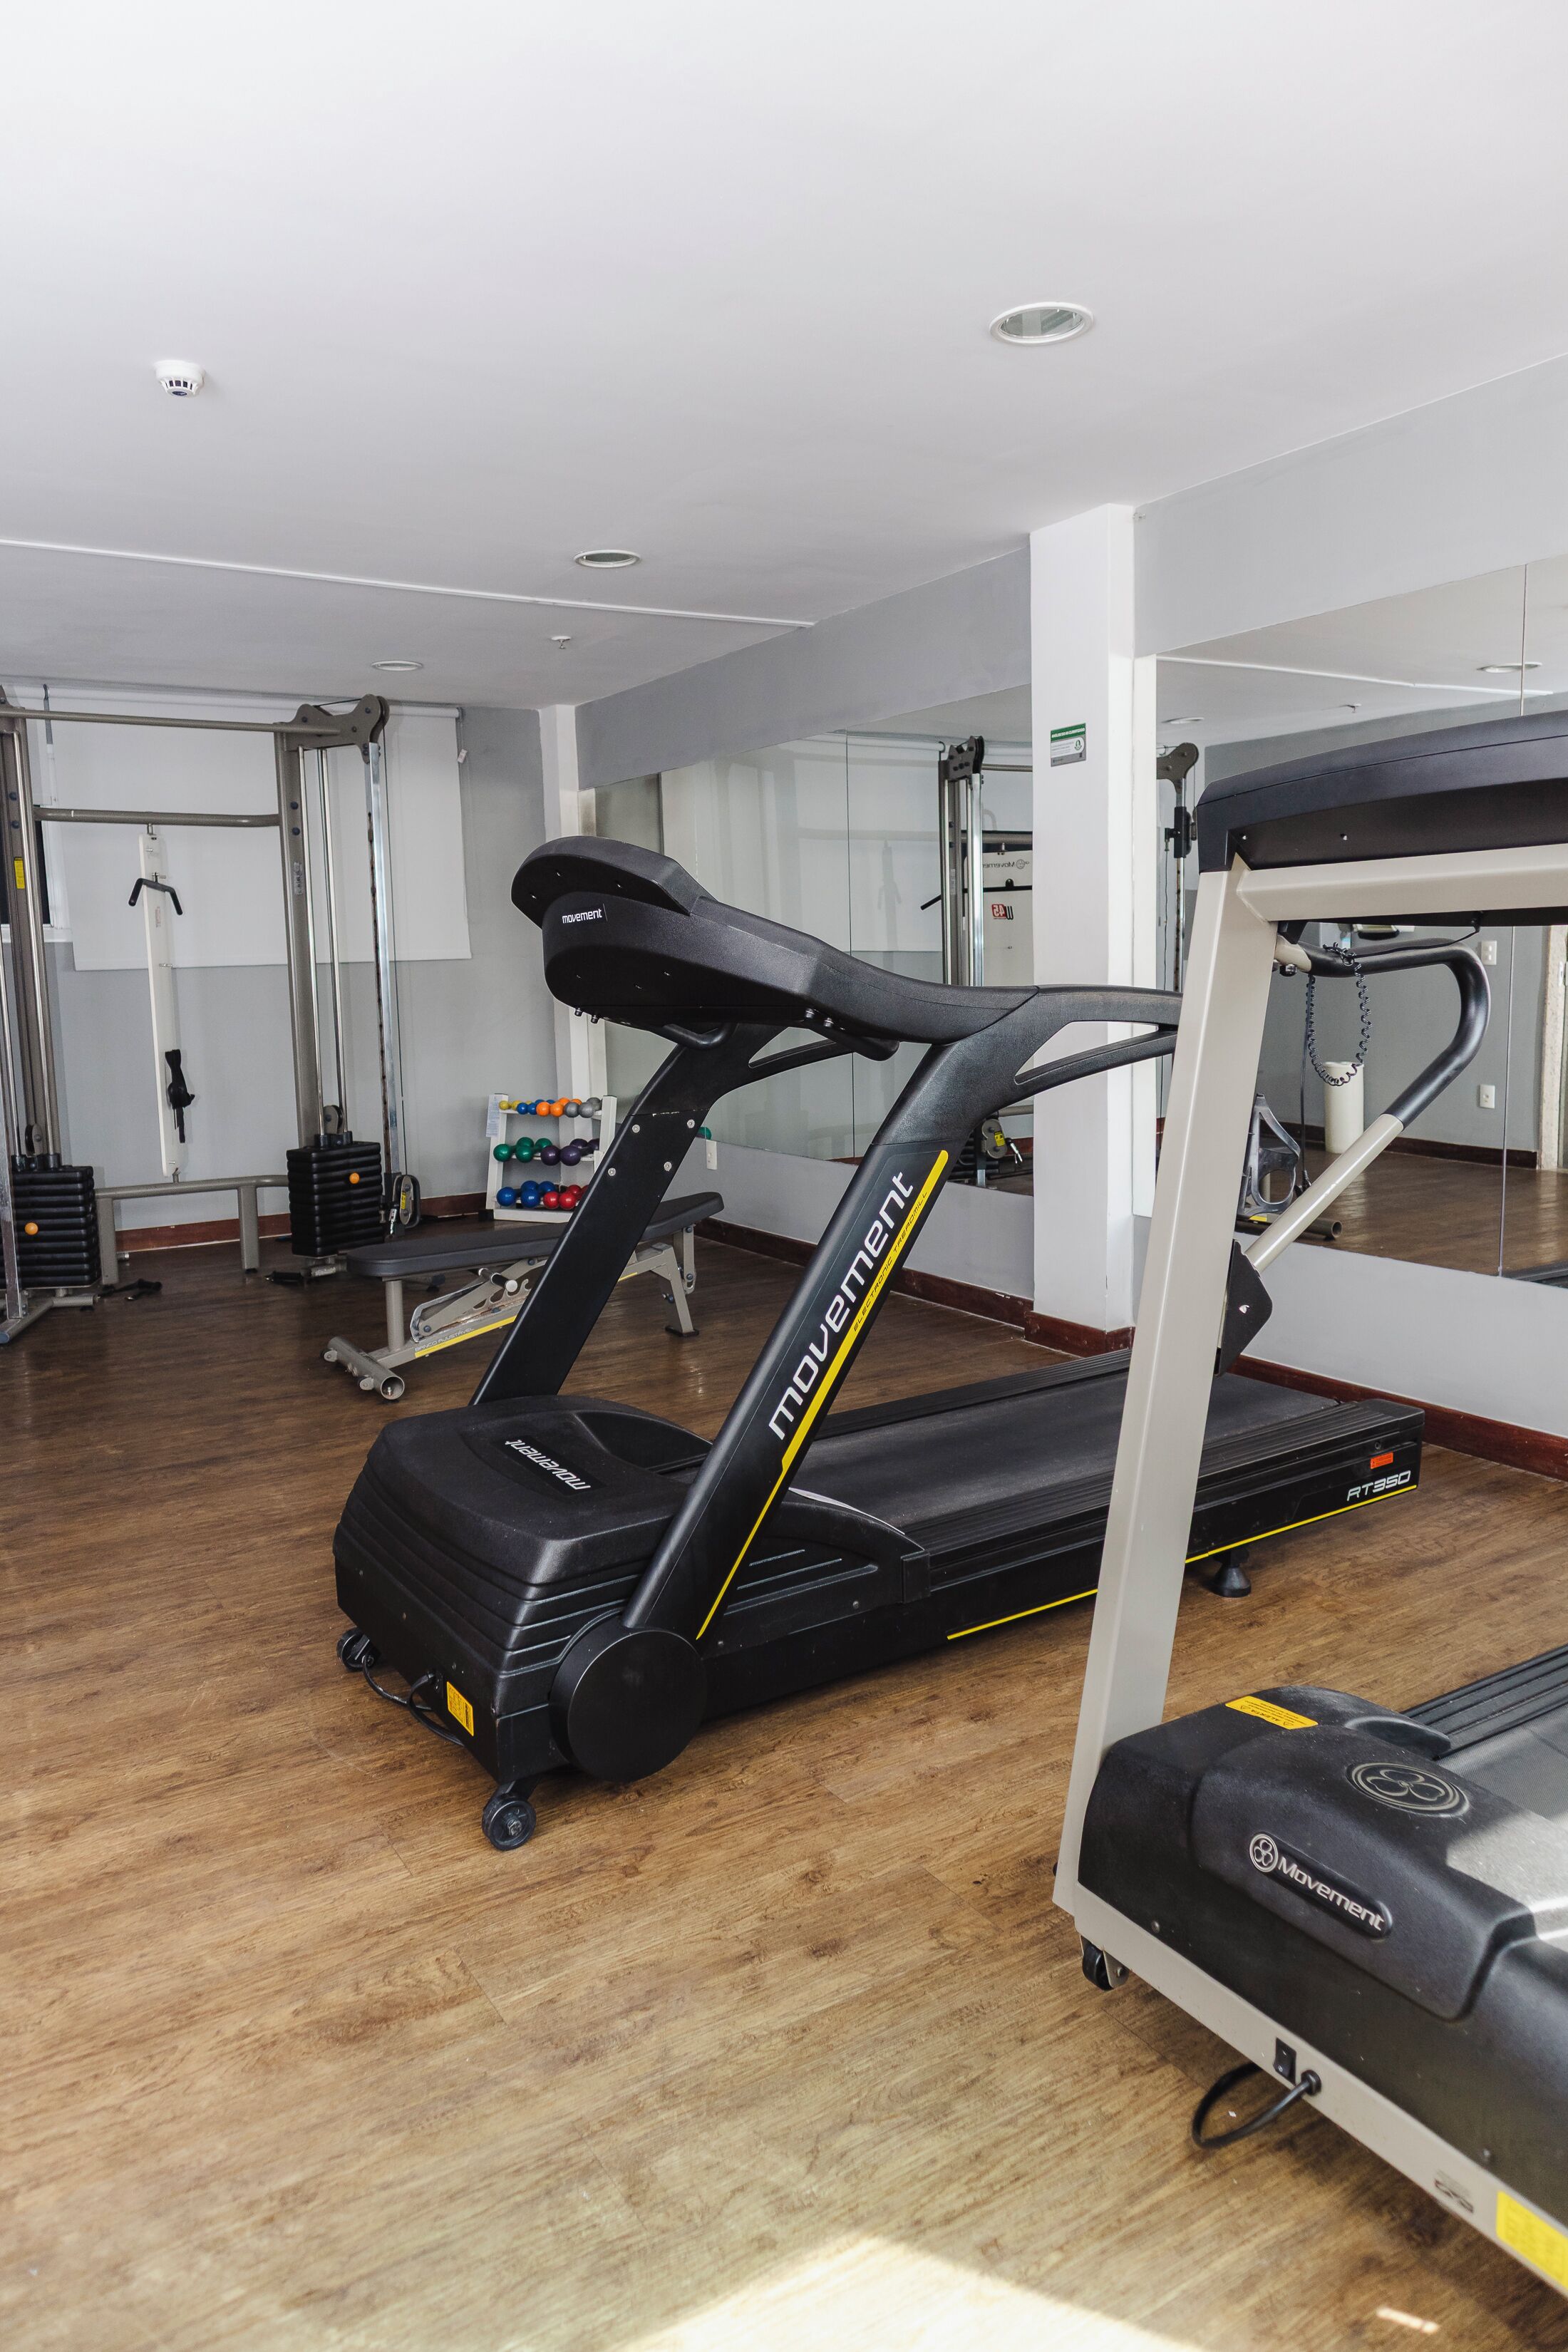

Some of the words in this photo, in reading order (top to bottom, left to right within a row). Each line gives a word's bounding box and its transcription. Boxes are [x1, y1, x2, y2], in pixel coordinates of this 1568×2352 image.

[562, 908, 602, 924] movement
[853, 1256, 893, 1332] ELECTRONIC
[893, 1191, 928, 1254] TREADMILL
[768, 1171, 914, 1441] movement
[414, 1340, 438, 1352] BANCO
[505, 1439, 592, 1490] movement
[1346, 1470, 1411, 1502] RT350
[1277, 1855, 1386, 1931] Movement
